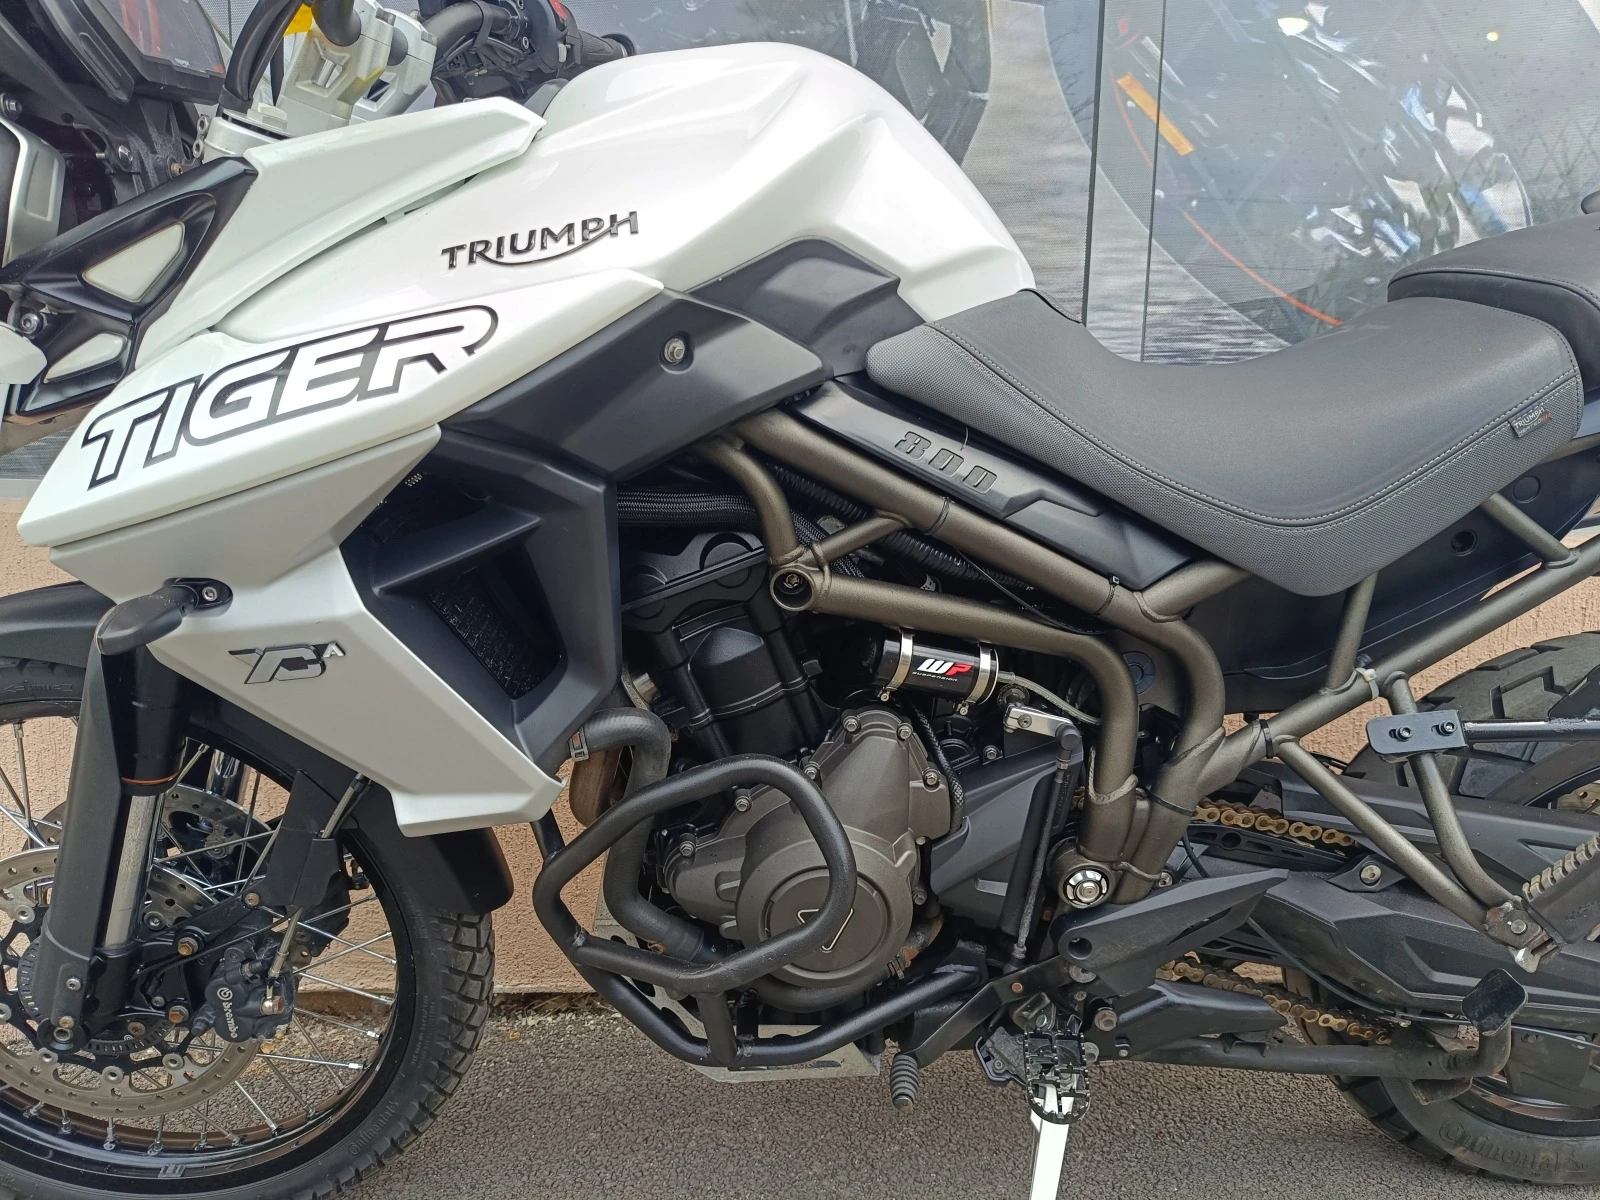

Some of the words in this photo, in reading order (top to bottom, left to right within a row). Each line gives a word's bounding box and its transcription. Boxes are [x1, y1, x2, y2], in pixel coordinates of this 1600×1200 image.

[441, 211, 639, 269] TRIUMPH
[81, 304, 499, 491] TIGER
[1514, 406, 1545, 429] TRIUMPH
[895, 431, 998, 494] 800
[911, 671, 959, 682] SUSPENSION
[917, 658, 973, 677] WP
[222, 1001, 239, 1039] brembo
